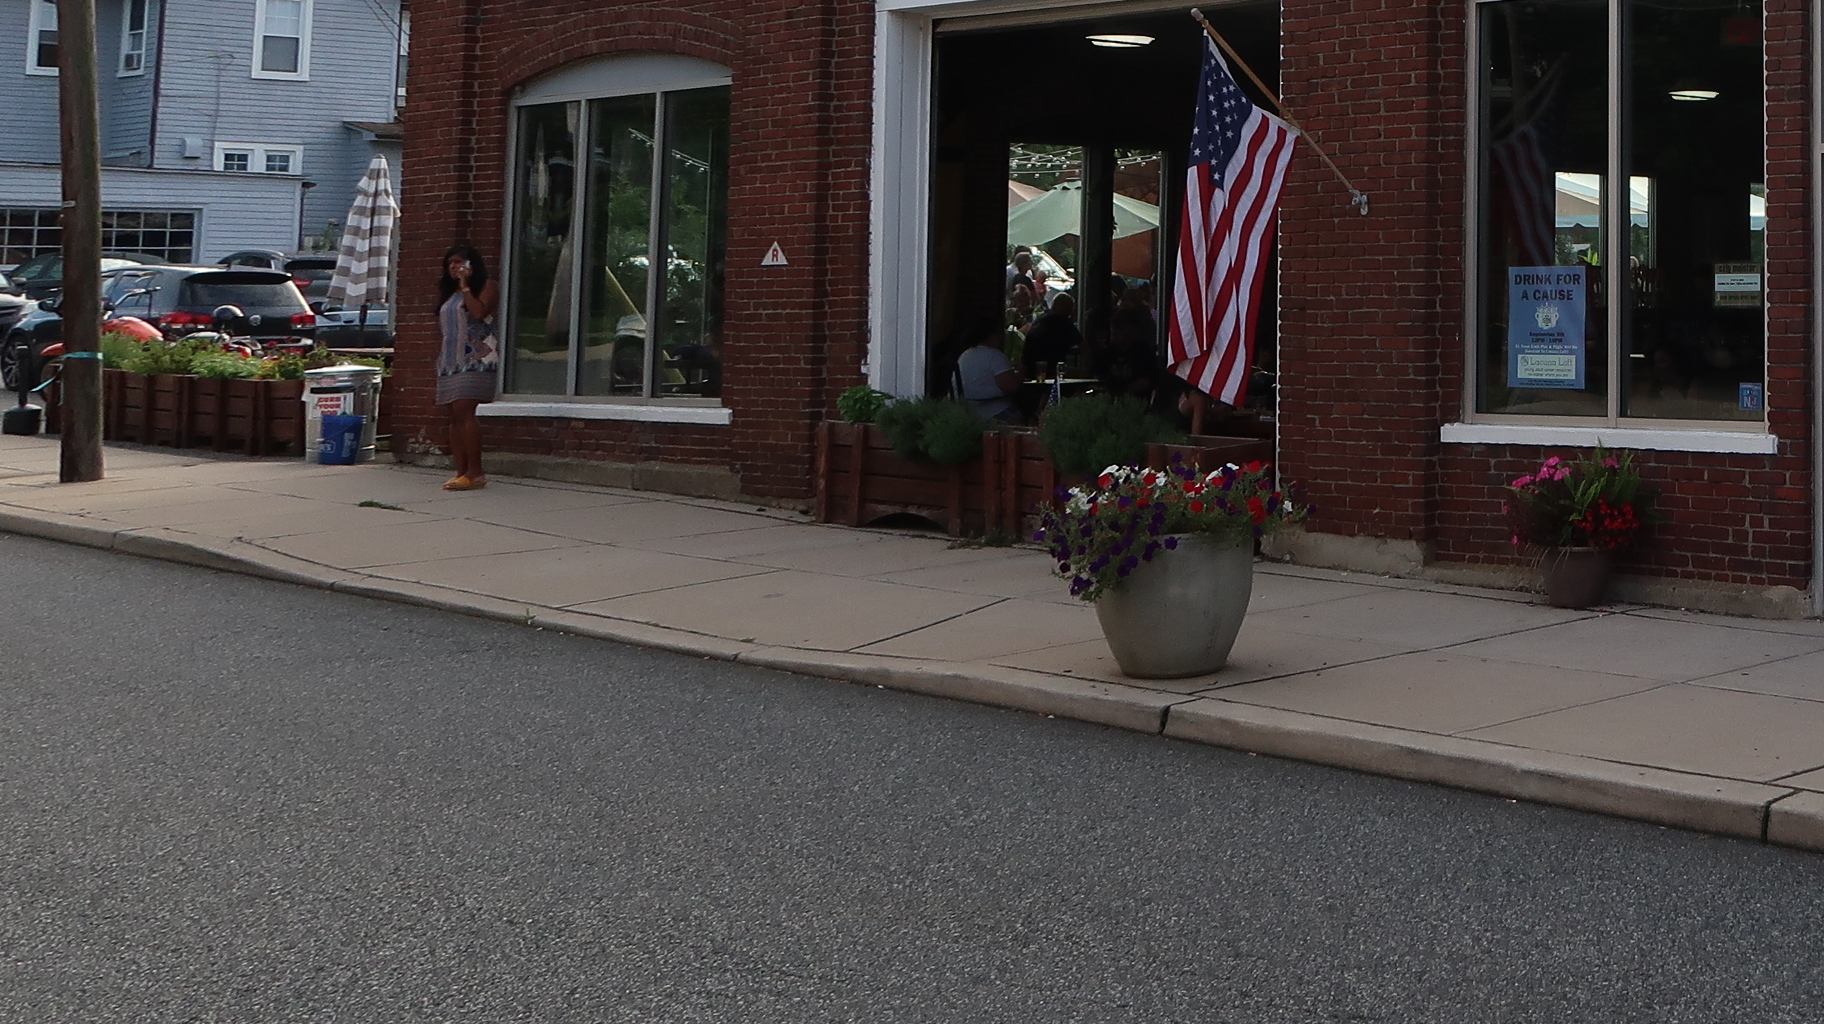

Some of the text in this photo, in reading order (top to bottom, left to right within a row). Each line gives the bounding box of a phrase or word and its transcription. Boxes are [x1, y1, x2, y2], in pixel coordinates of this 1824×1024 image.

[1514, 273, 1581, 285] DRINK FOR
[1521, 289, 1574, 301] A CAUSE
[1530, 356, 1573, 366] Lacuna Loft
